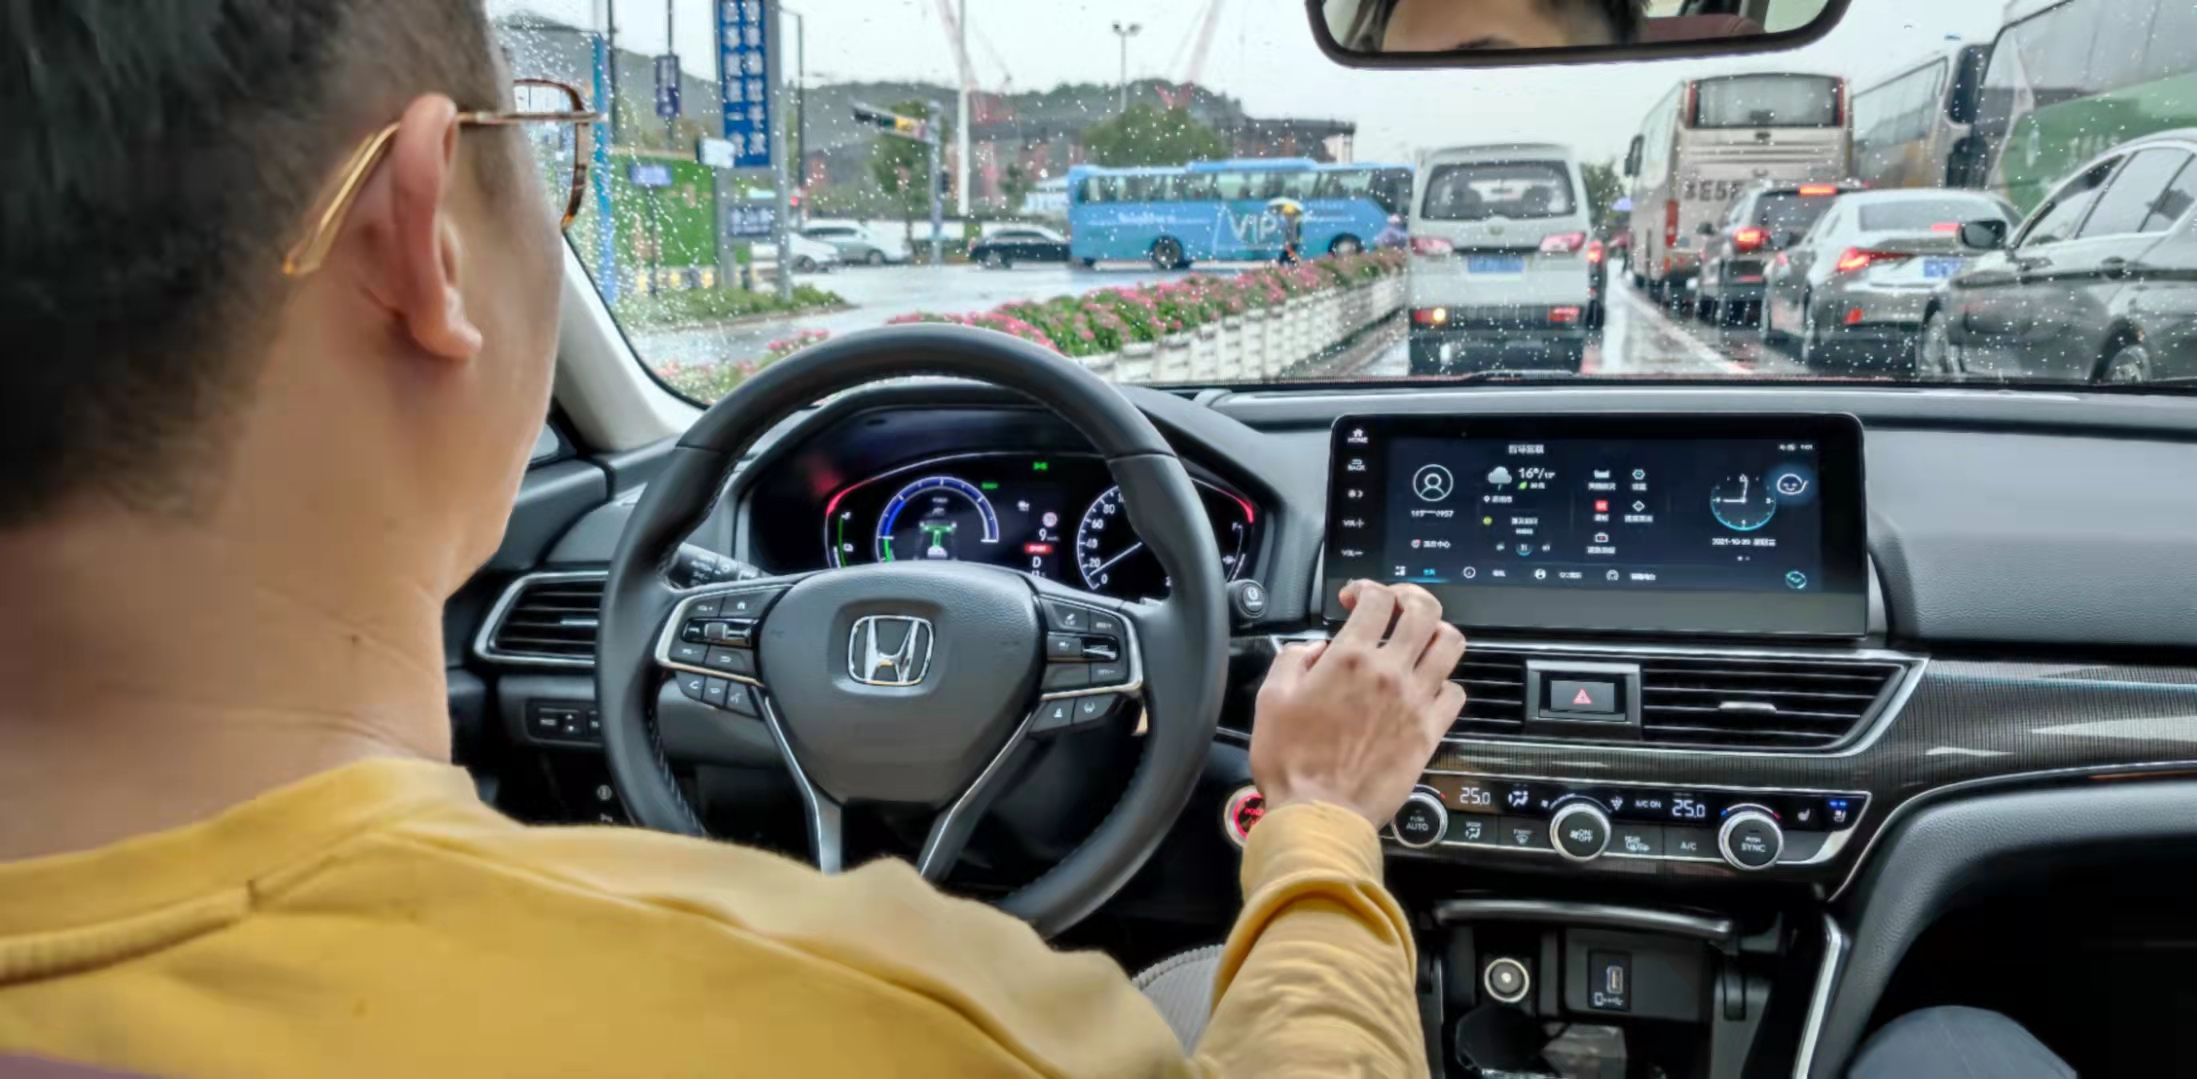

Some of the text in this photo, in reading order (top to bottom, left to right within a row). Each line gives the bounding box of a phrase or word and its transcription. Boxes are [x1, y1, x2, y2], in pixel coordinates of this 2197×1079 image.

[1229, 211, 1277, 244] VIP
[1102, 503, 1115, 514] 80
[1091, 518, 1104, 530] 60
[1038, 528, 1047, 542] 9
[1086, 537, 1098, 549] 40
[1032, 555, 1042, 568] D
[1088, 556, 1101, 569] 20
[1101, 573, 1109, 585] 0
[1459, 786, 1491, 805] 25.0
[1650, 800, 1662, 809] ON
[1672, 799, 1706, 818] 25.0
[1406, 822, 1429, 832] AUTO
[1680, 841, 1697, 850] A/C
[1740, 842, 1766, 853] SYNC
